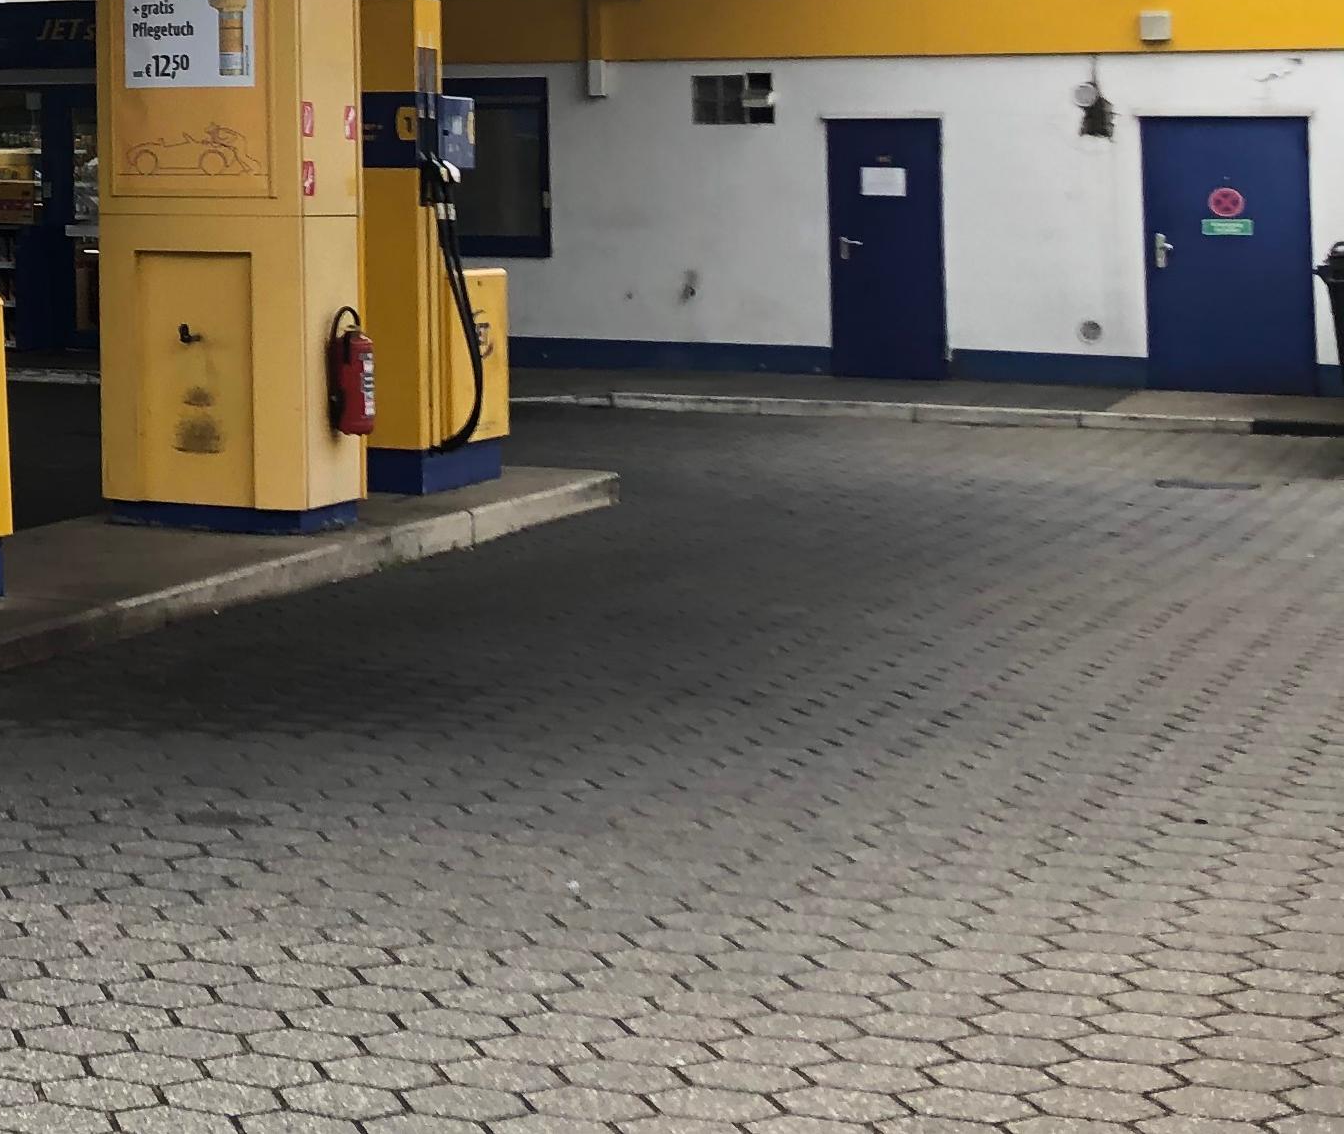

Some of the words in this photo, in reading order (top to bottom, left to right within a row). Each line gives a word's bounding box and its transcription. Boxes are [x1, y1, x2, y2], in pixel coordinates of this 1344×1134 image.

[141, 0, 174, 19] gratis
[36, 18, 84, 41] JET
[132, 21, 194, 40] Pflegetuch
